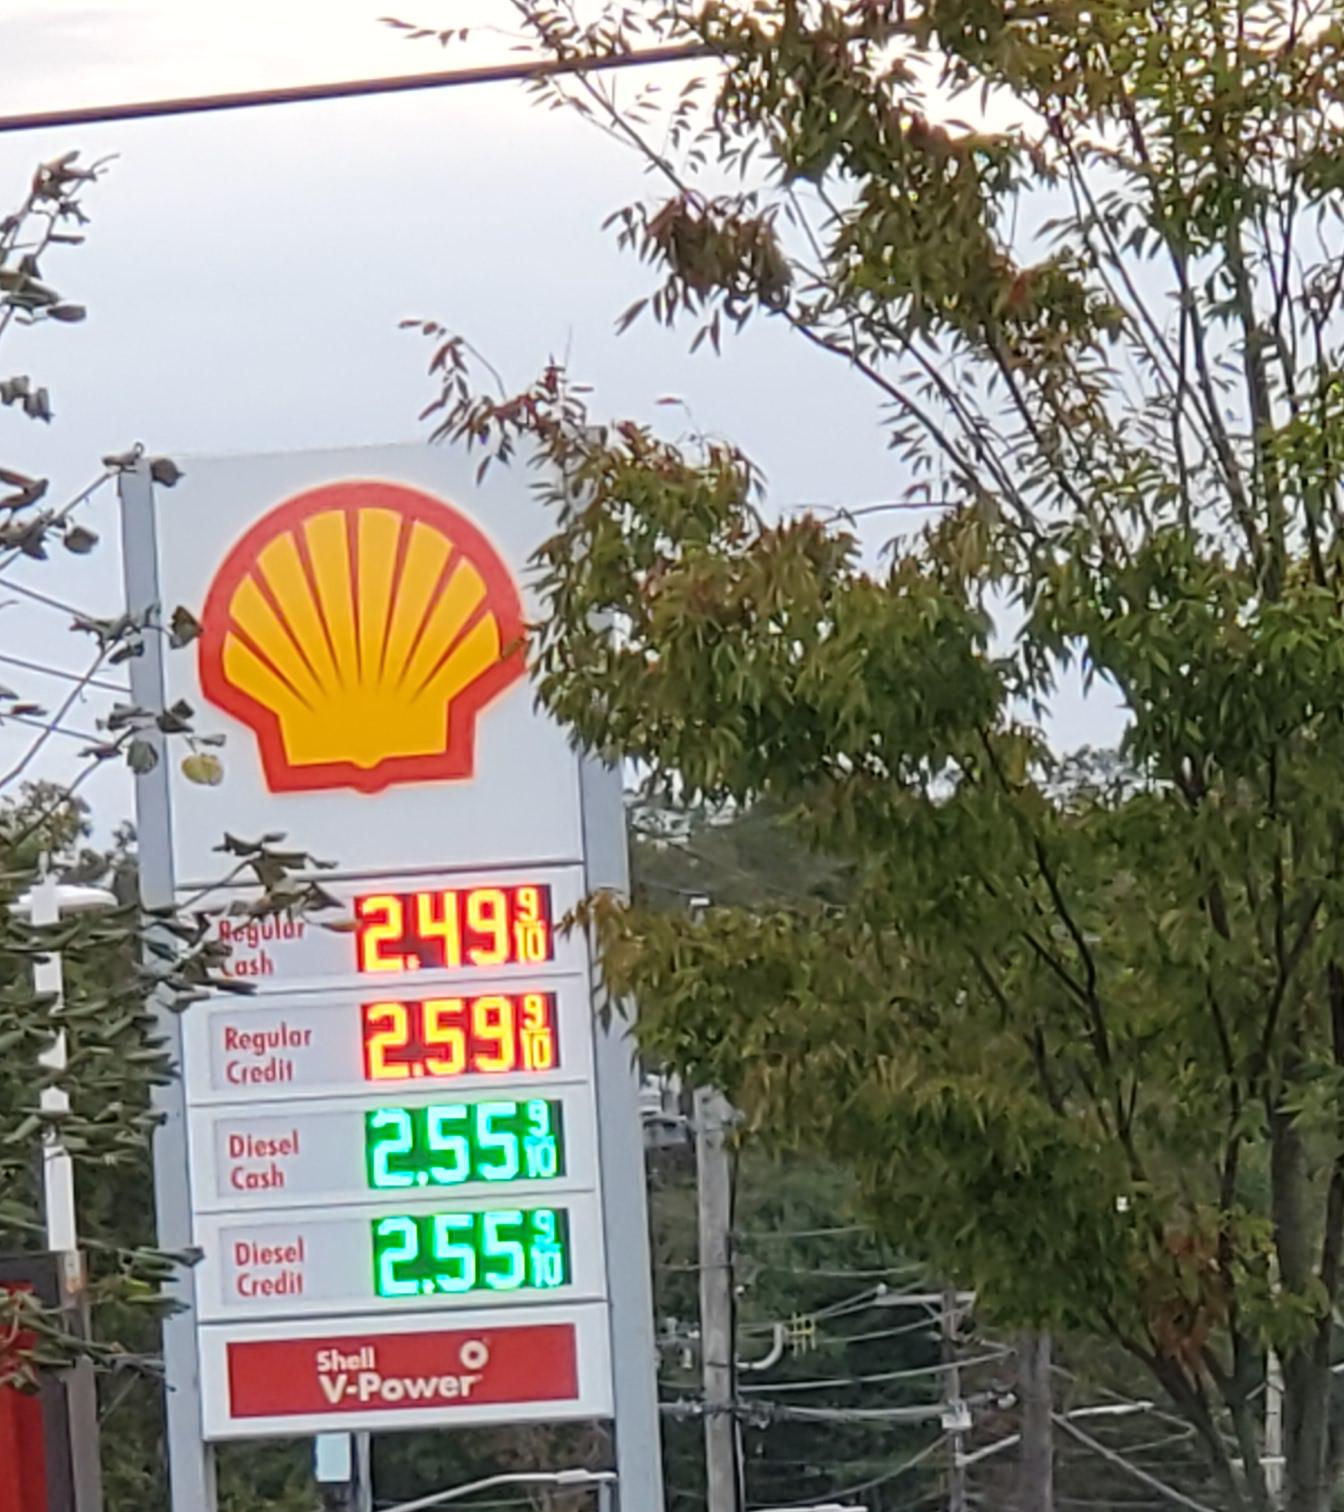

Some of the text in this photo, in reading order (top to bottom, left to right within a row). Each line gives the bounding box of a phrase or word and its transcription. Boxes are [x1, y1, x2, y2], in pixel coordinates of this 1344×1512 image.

[219, 912, 304, 948] Regular
[362, 888, 509, 972] 2.49
[224, 1022, 312, 1056] Regular
[368, 996, 515, 1080] 2.59
[226, 1057, 293, 1085] Credit
[229, 1129, 299, 1159] Diesel
[371, 1101, 520, 1188] 2.55
[231, 1162, 284, 1190] Cash
[234, 1235, 304, 1266] Diesel
[378, 1210, 526, 1297] 2.55
[237, 1269, 303, 1297] Credit
[316, 1346, 375, 1372] Shell
[318, 1372, 473, 1404] V-Power
